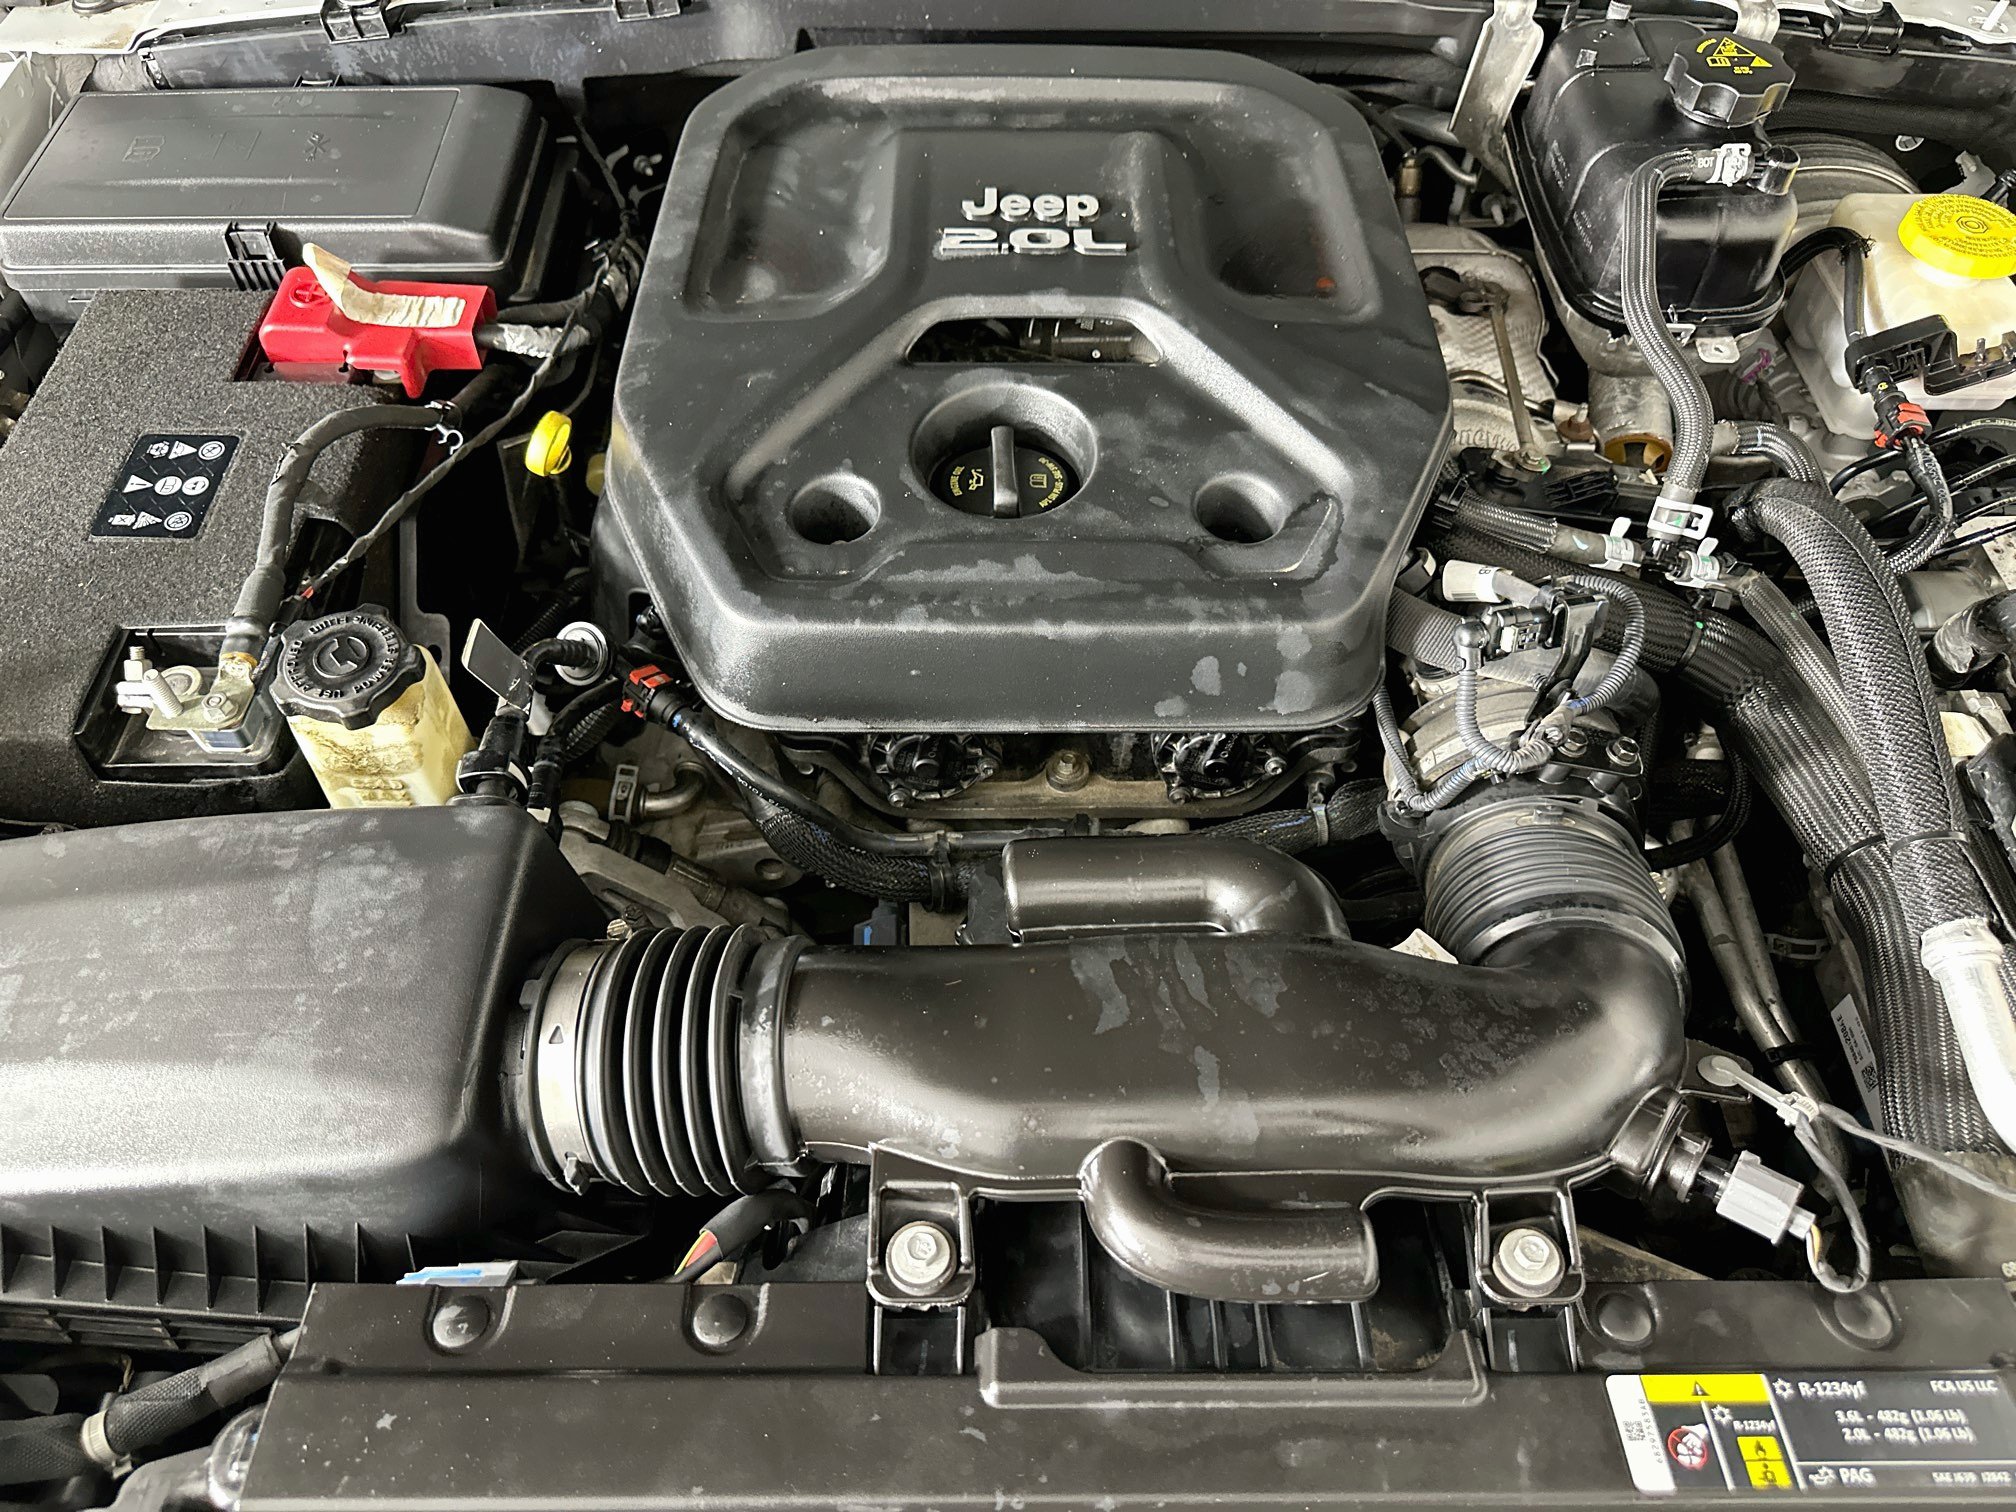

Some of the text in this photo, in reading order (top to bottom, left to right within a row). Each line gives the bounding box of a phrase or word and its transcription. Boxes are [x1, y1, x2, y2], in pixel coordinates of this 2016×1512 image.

[962, 187, 1099, 227] Jeep
[941, 227, 1127, 256] 2.0L
[308, 615, 401, 694] POWER STEERING FLUID
[1798, 1380, 1868, 1399] R-1234yf
[1930, 1380, 1999, 1394] FCA US LLC
[1733, 1420, 1776, 1433] R-1234yf
[1835, 1410, 1864, 1424] 3.6L
[1877, 1410, 1911, 1427] 482g
[1841, 1428, 1871, 1443] 2.0L
[1884, 1427, 1918, 1445] 482g
[1838, 1468, 1876, 1485] PAG
